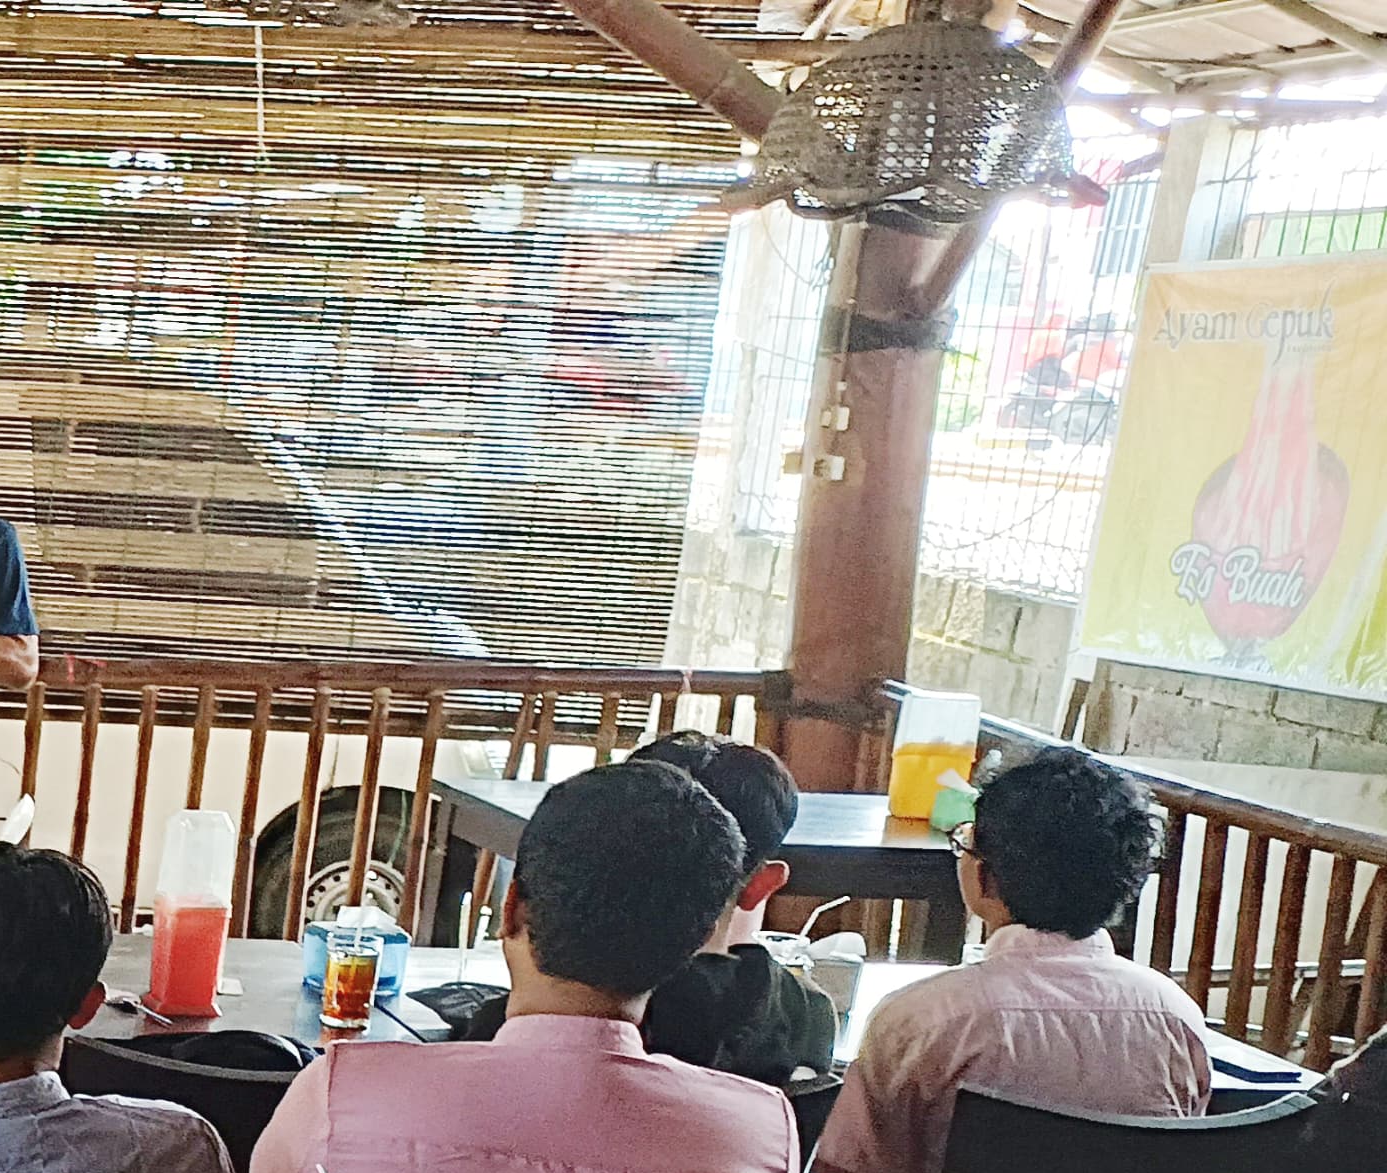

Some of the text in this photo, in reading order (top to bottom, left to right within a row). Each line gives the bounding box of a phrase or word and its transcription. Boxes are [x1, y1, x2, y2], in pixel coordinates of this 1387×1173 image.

[1153, 306, 1237, 350] Ayam
[1170, 542, 1305, 609] Es Buah
